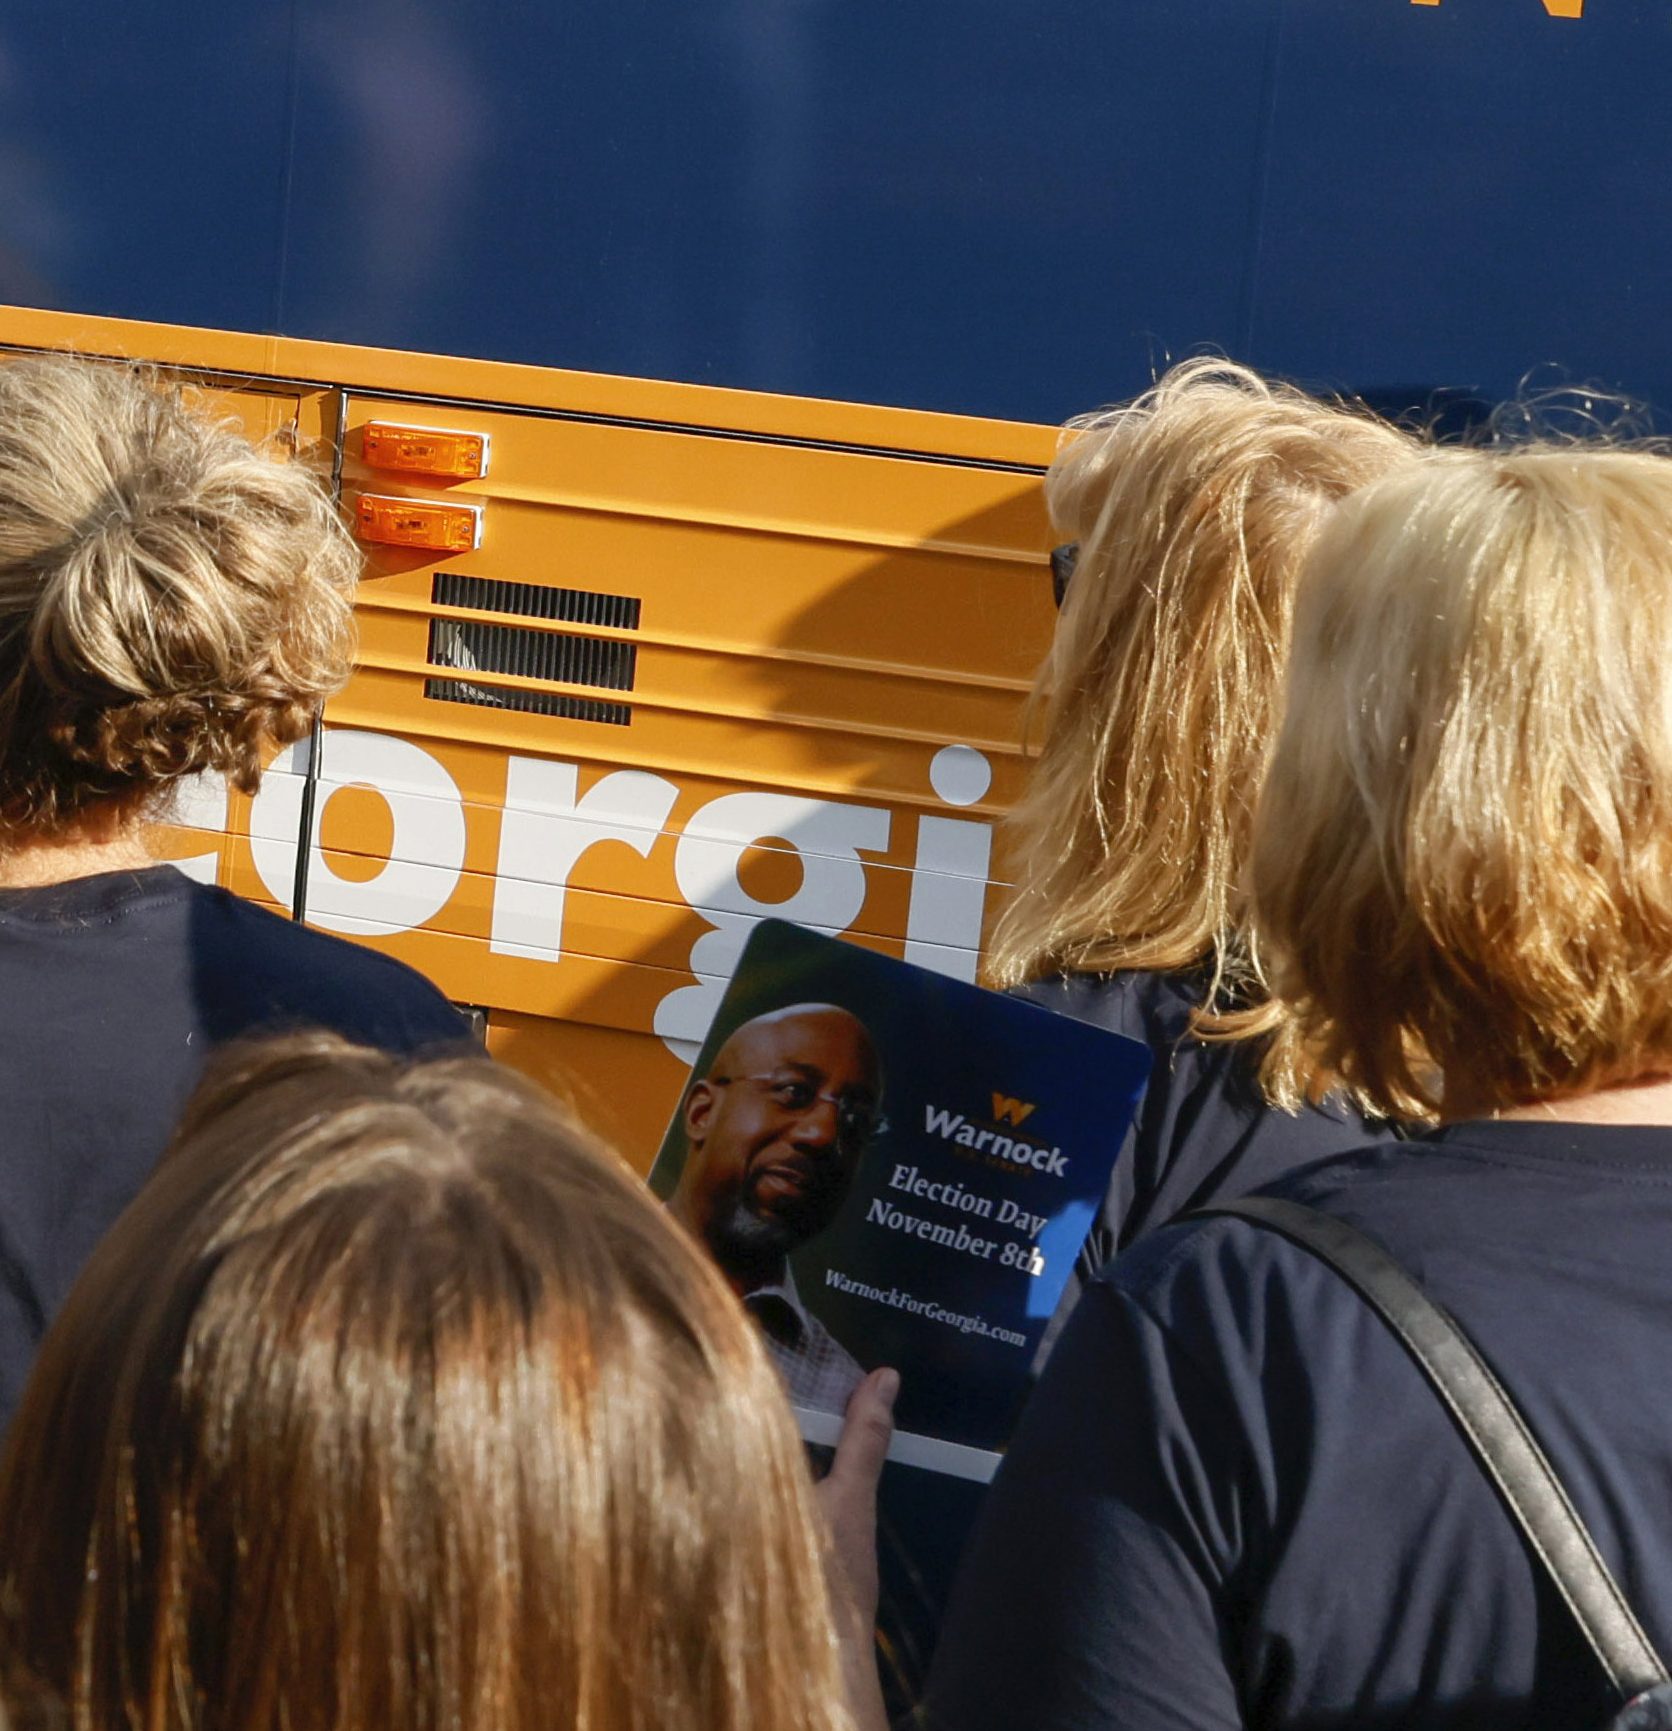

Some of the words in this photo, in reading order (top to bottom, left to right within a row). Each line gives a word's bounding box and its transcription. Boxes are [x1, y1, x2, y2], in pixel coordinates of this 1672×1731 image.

[924, 1104, 1070, 1178] Warnock
[865, 1197, 998, 1260] November
[999, 1241, 1048, 1278] 8th
[888, 1164, 993, 1219] Election
[996, 1198, 1048, 1240] Day
[824, 1268, 1028, 1348] WarnockForGeorgia.com
